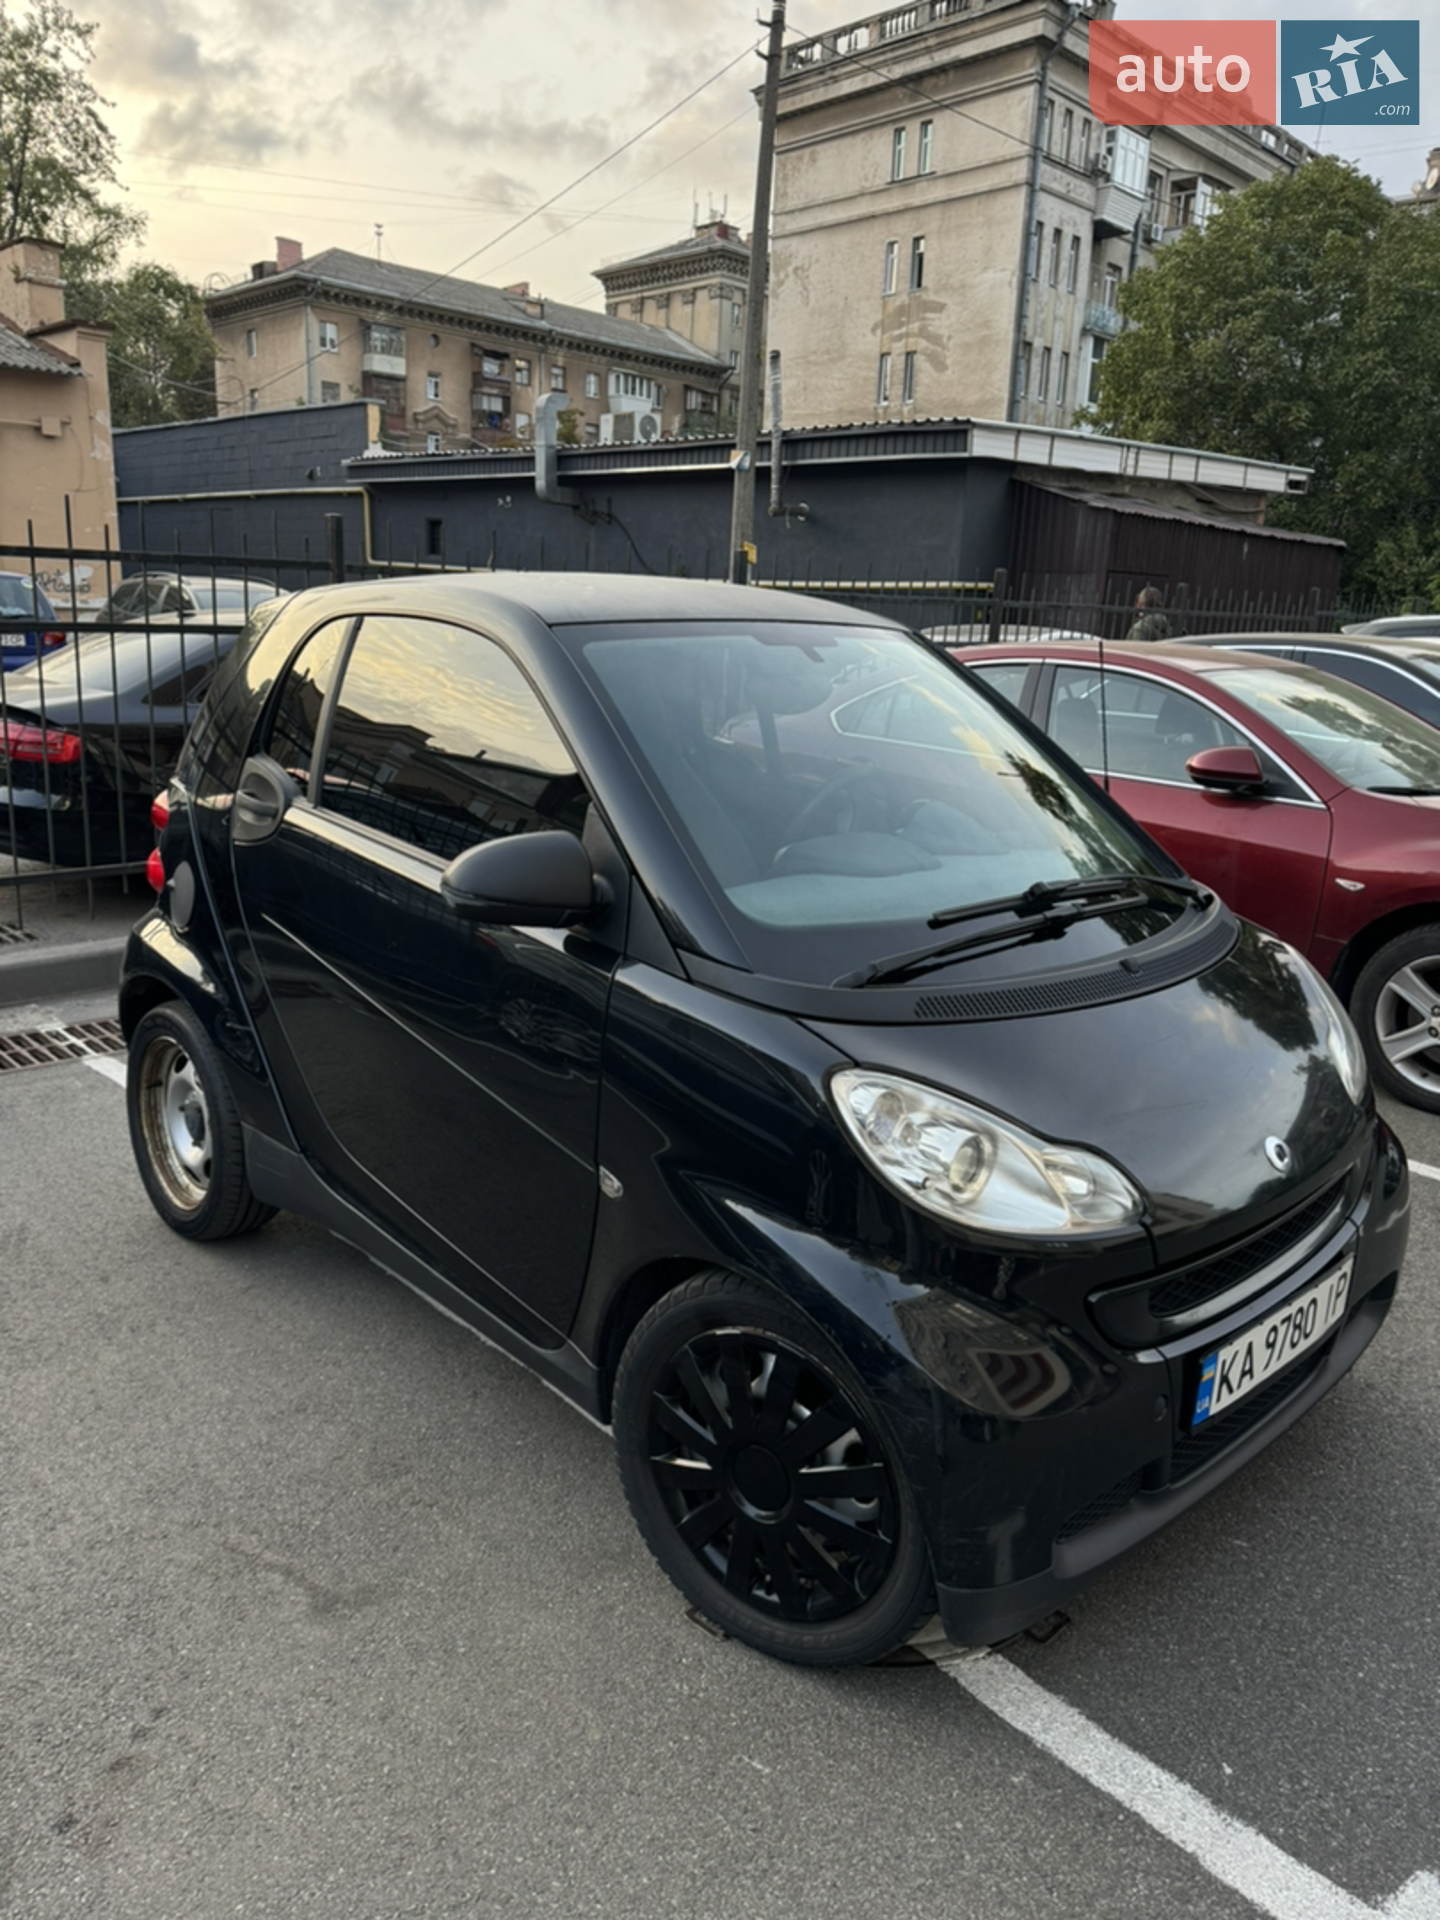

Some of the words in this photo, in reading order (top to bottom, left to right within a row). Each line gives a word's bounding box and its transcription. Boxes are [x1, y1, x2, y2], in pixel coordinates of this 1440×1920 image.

[1216, 1341, 1254, 1403] KA
[1263, 1297, 1318, 1372] 9780
[1324, 1271, 1348, 1325] IP
